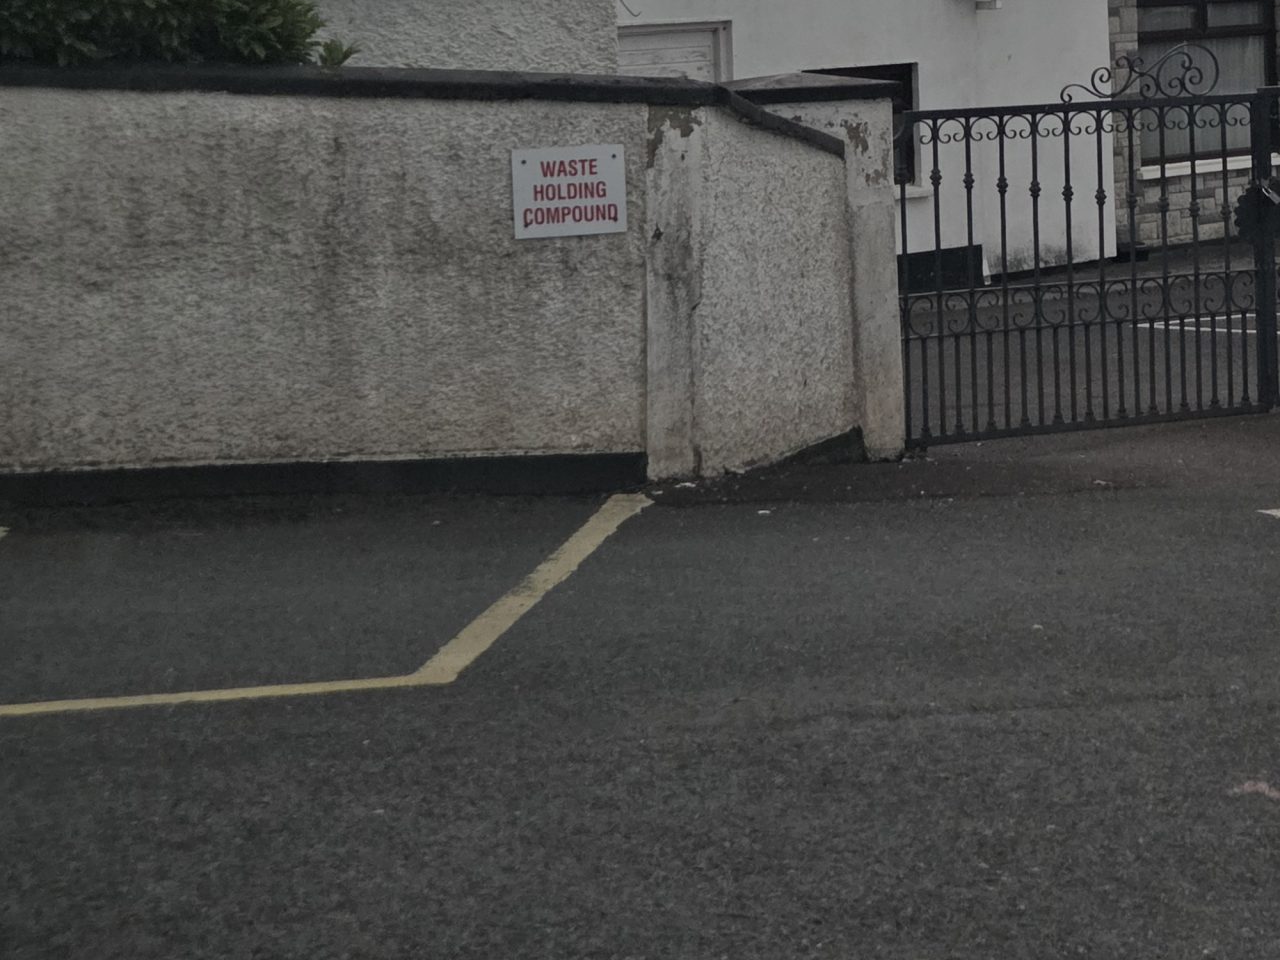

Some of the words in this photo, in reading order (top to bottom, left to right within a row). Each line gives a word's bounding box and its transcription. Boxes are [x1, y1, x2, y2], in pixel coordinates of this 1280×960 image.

[540, 158, 598, 178] WASTE
[533, 181, 607, 201] HOLDING
[523, 204, 618, 225] COMPOUND
